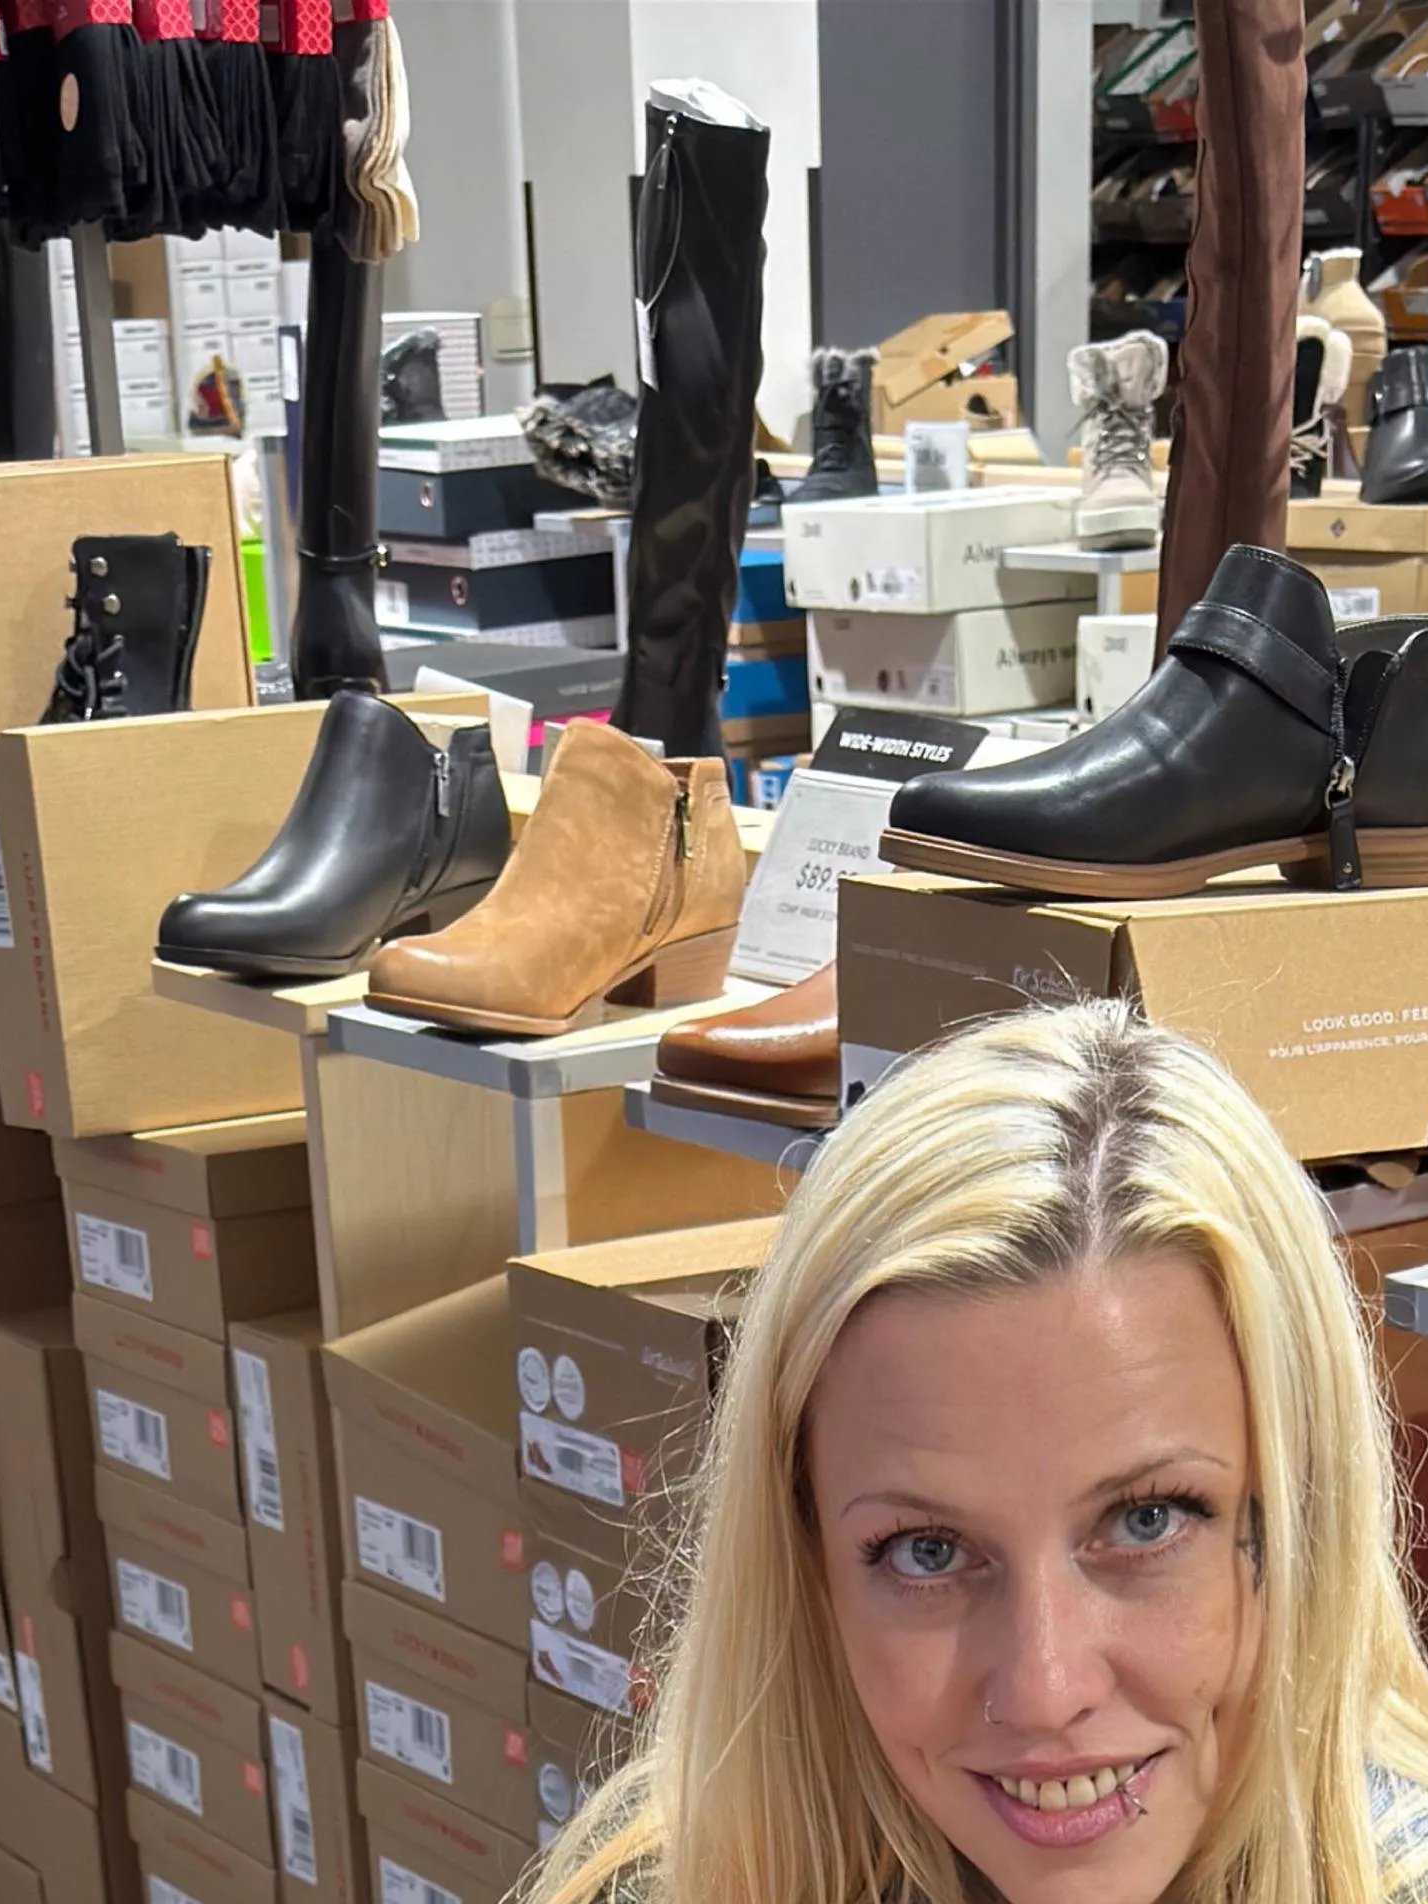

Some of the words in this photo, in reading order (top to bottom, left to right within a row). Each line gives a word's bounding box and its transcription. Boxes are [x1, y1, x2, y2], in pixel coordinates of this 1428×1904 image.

[839, 731, 909, 759] WIDE-WIDTH
[909, 740, 955, 764] STYLES
[1302, 1015, 1347, 1034] LOOK
[1349, 1010, 1400, 1029] GOOD.
[1395, 1031, 1428, 1046] POUR
